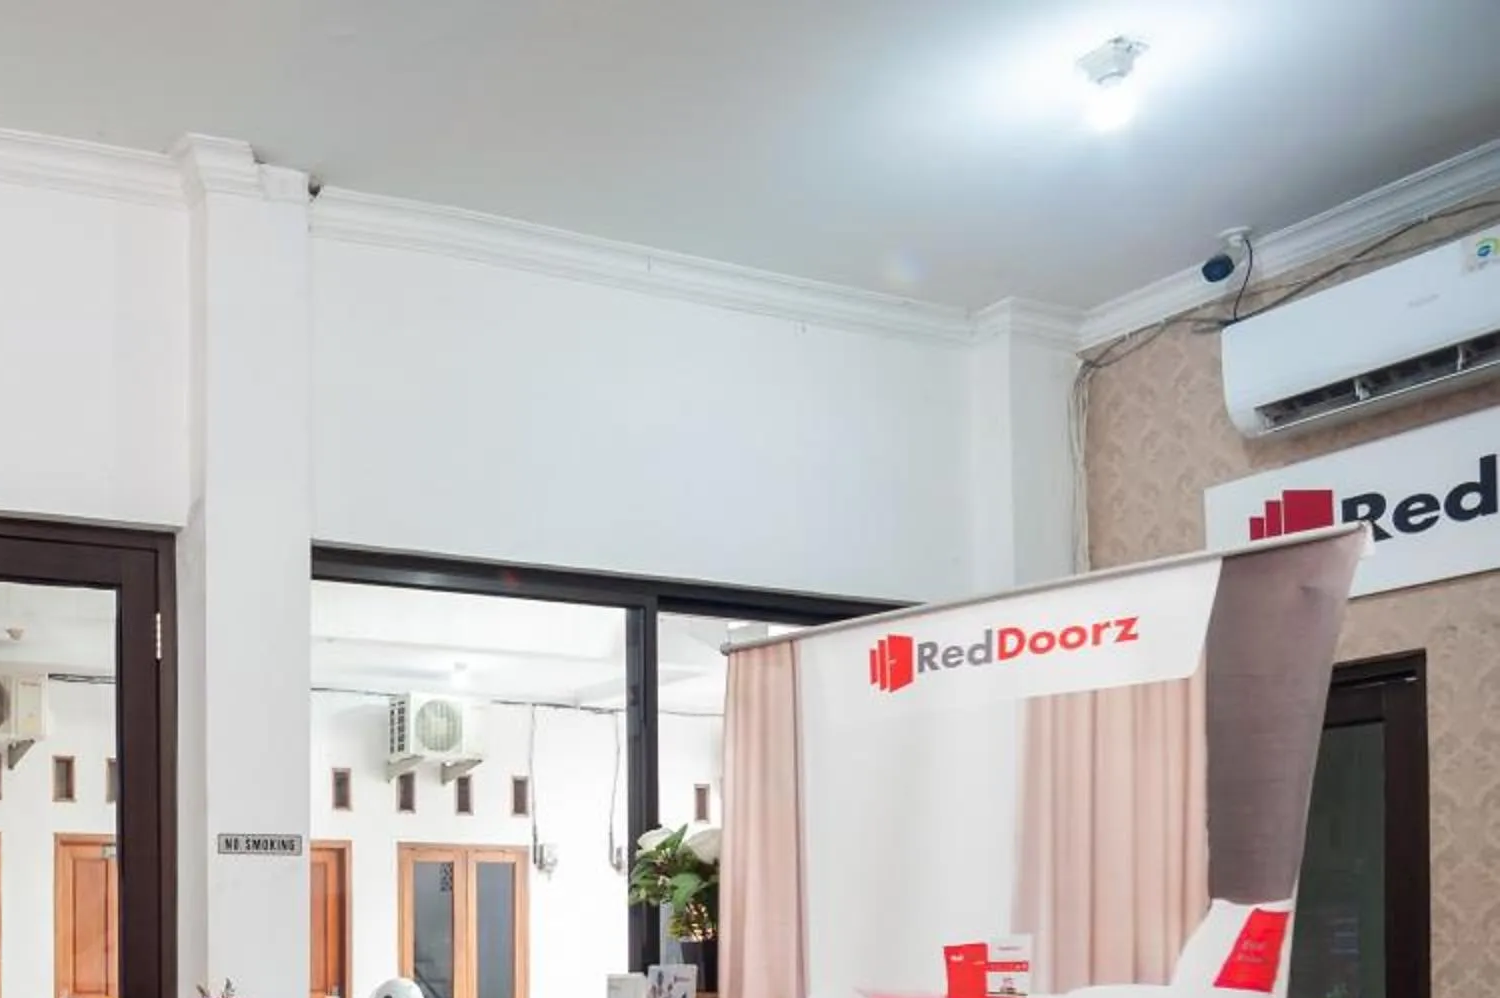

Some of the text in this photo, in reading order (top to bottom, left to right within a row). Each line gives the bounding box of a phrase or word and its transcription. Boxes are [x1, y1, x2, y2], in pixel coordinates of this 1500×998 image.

[1341, 453, 1498, 542] Red
[916, 616, 1139, 673] RedDoorz
[225, 837, 295, 852] NO SMOKING
